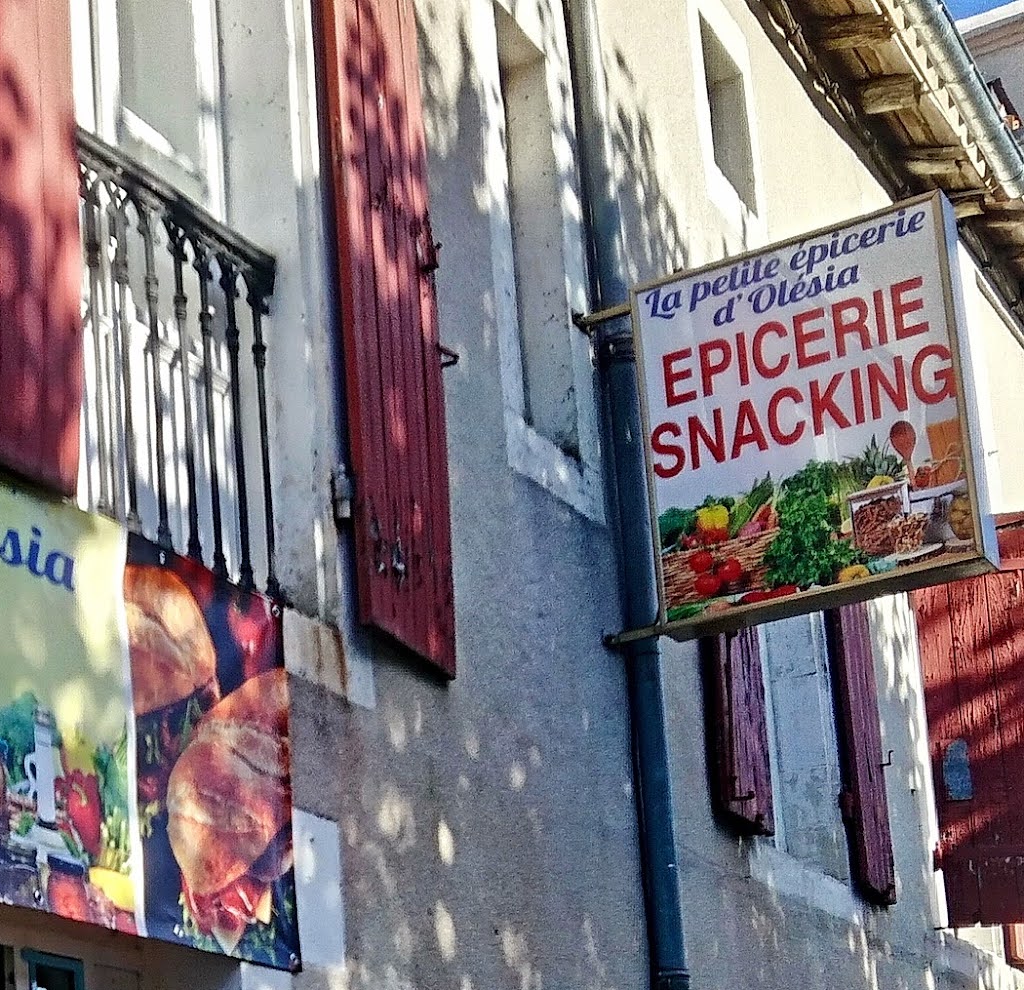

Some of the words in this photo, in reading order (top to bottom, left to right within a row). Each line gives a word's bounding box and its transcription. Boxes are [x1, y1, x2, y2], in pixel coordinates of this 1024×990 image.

[644, 287, 682, 319] La
[689, 257, 780, 312] petite
[789, 208, 926, 276] épicerie
[661, 276, 930, 408] EPICERIE
[650, 343, 958, 480] SNACKING
